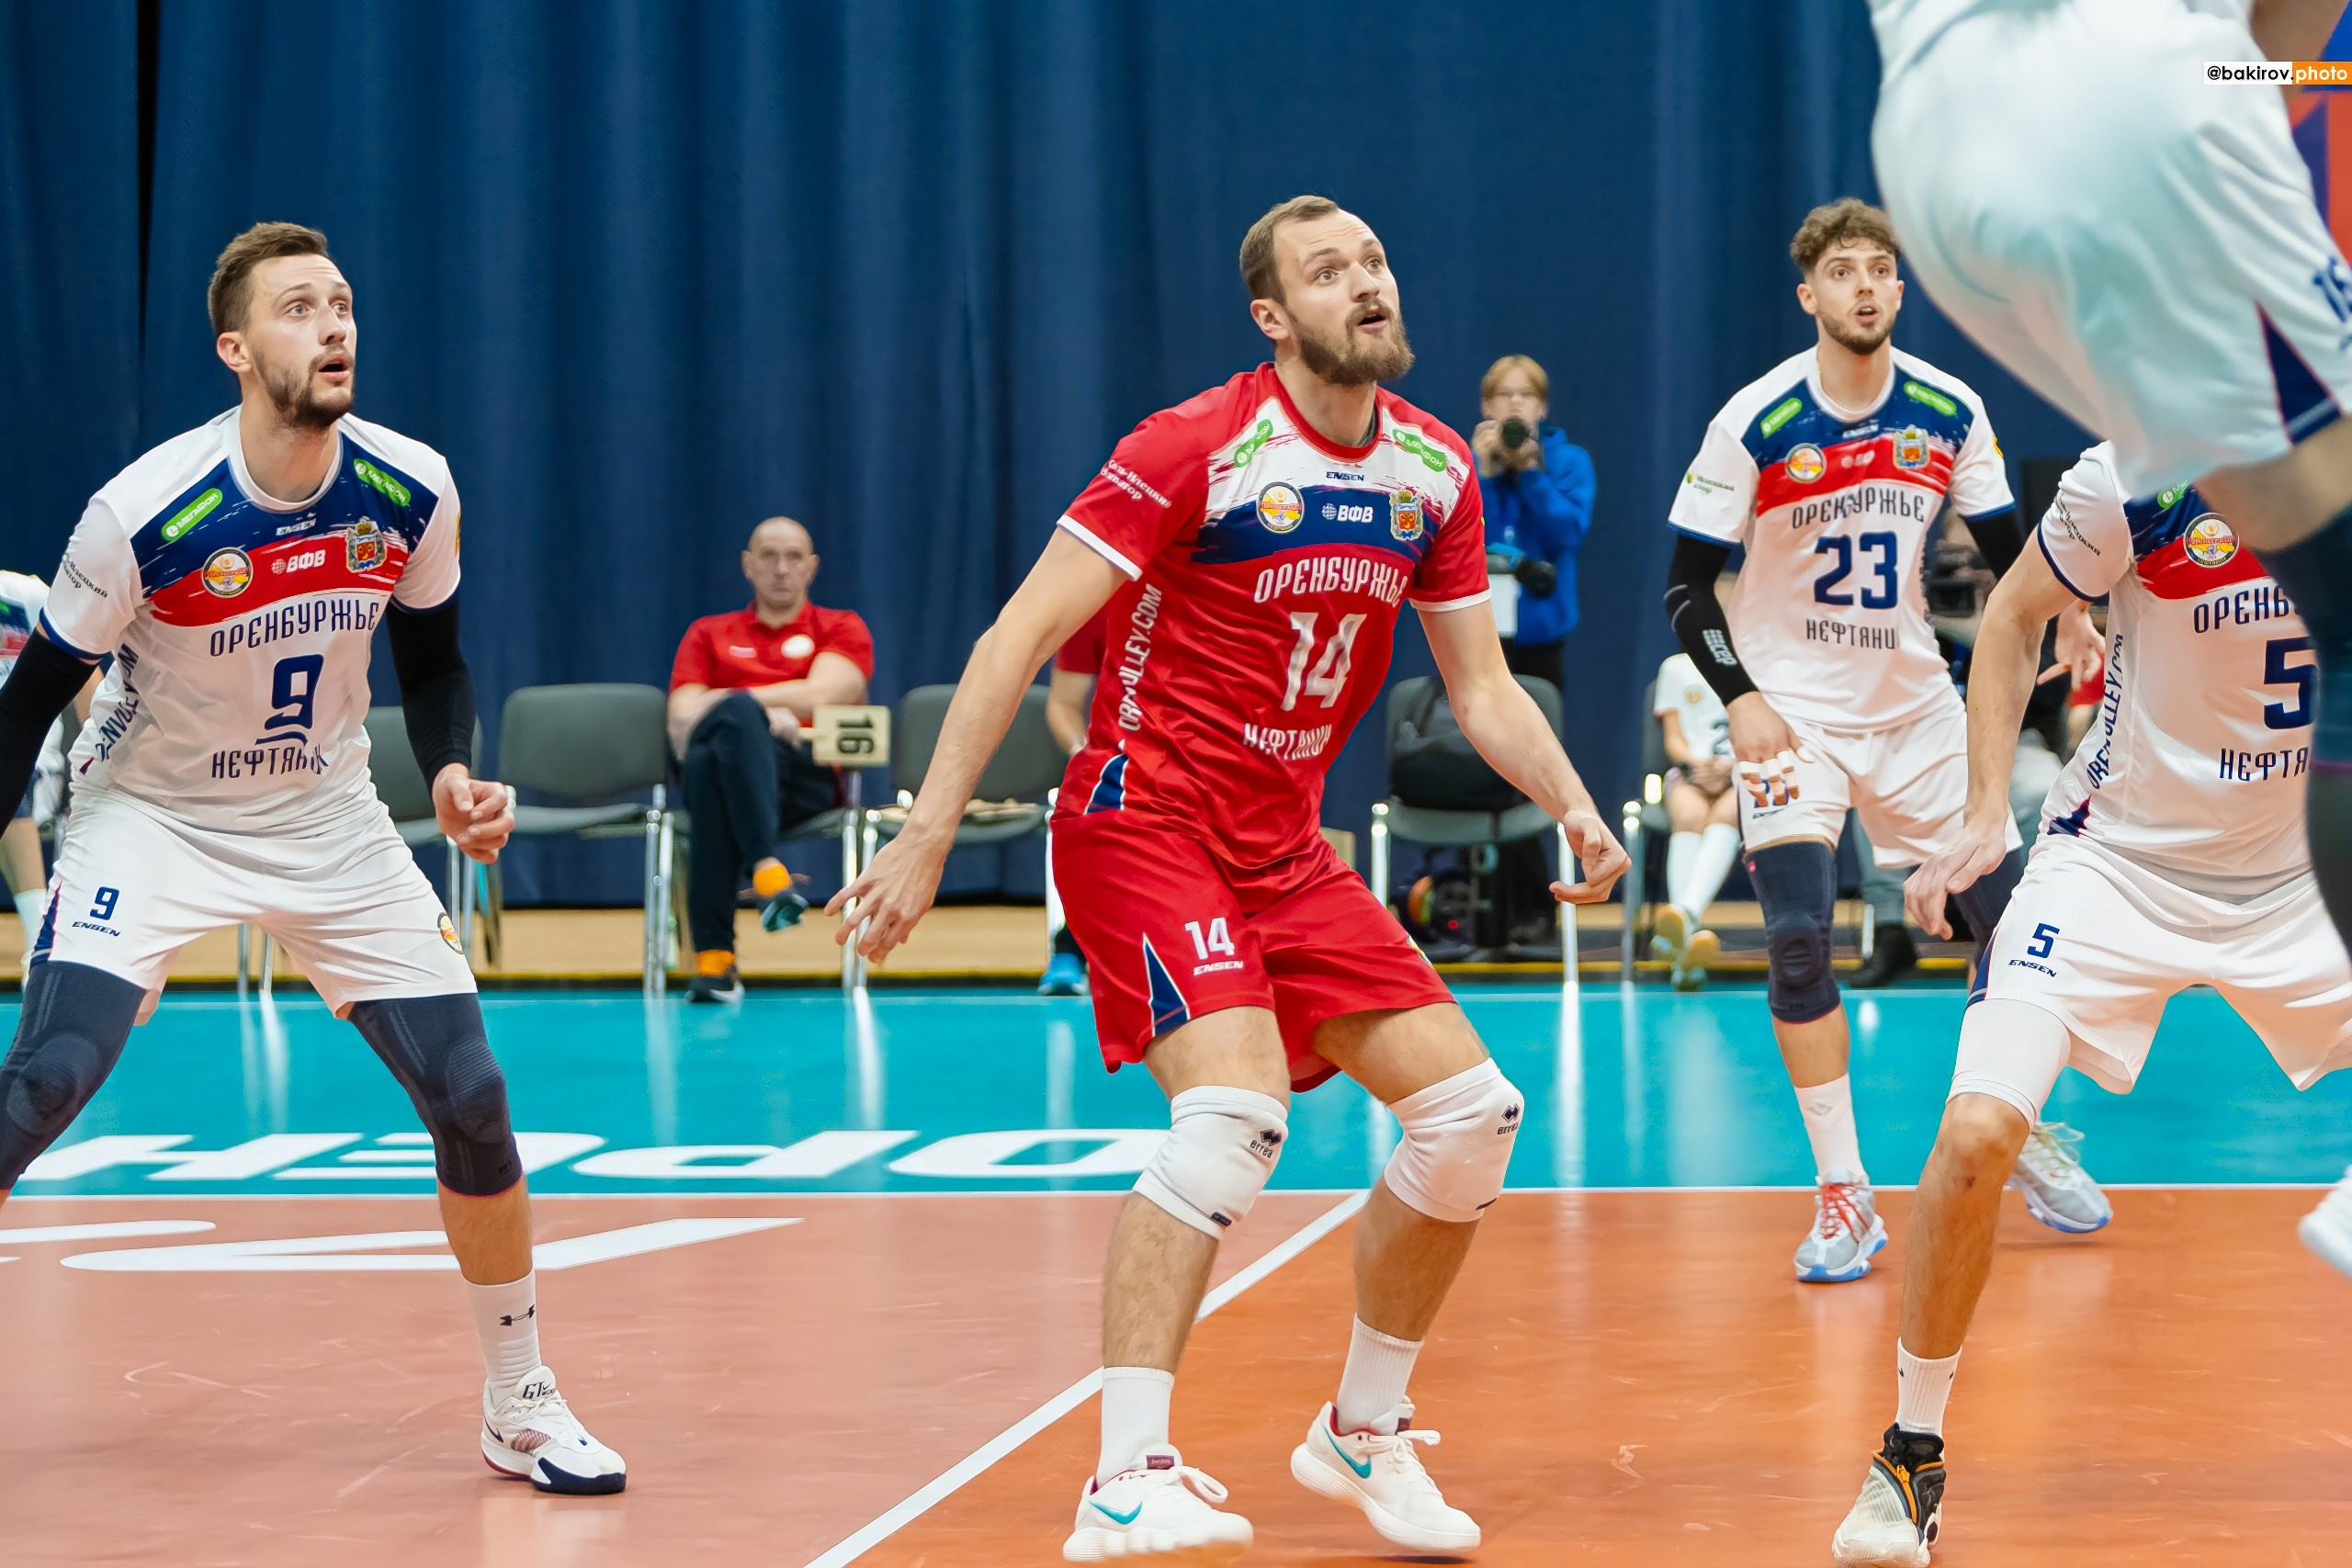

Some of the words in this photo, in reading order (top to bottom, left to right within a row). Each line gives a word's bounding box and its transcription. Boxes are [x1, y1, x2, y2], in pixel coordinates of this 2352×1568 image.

[1326, 471, 1365, 482] ENSEN
[1337, 505, 1374, 524] ВФВ
[286, 549, 326, 573] ВФВ
[1814, 530, 1898, 610] 23
[1253, 557, 1408, 608] ОРЕНБУРЖЬЕ
[209, 598, 379, 657] ОРЕНБУРЖЬЕ
[2193, 584, 2301, 634] ОРЕНБ
[1805, 618, 1900, 649] НЕФТЯНИ
[1280, 611, 1368, 712] 14
[254, 654, 324, 746] 9
[2263, 636, 2319, 730] 5
[837, 714, 874, 754] 16
[2219, 746, 2312, 782] НЕФТЯ
[90, 886, 119, 920] 9
[1184, 917, 1236, 960] 14
[2026, 922, 2061, 959] 5
[1193, 960, 1244, 976] ENSEN
[2007, 959, 2057, 978] ENSEN
